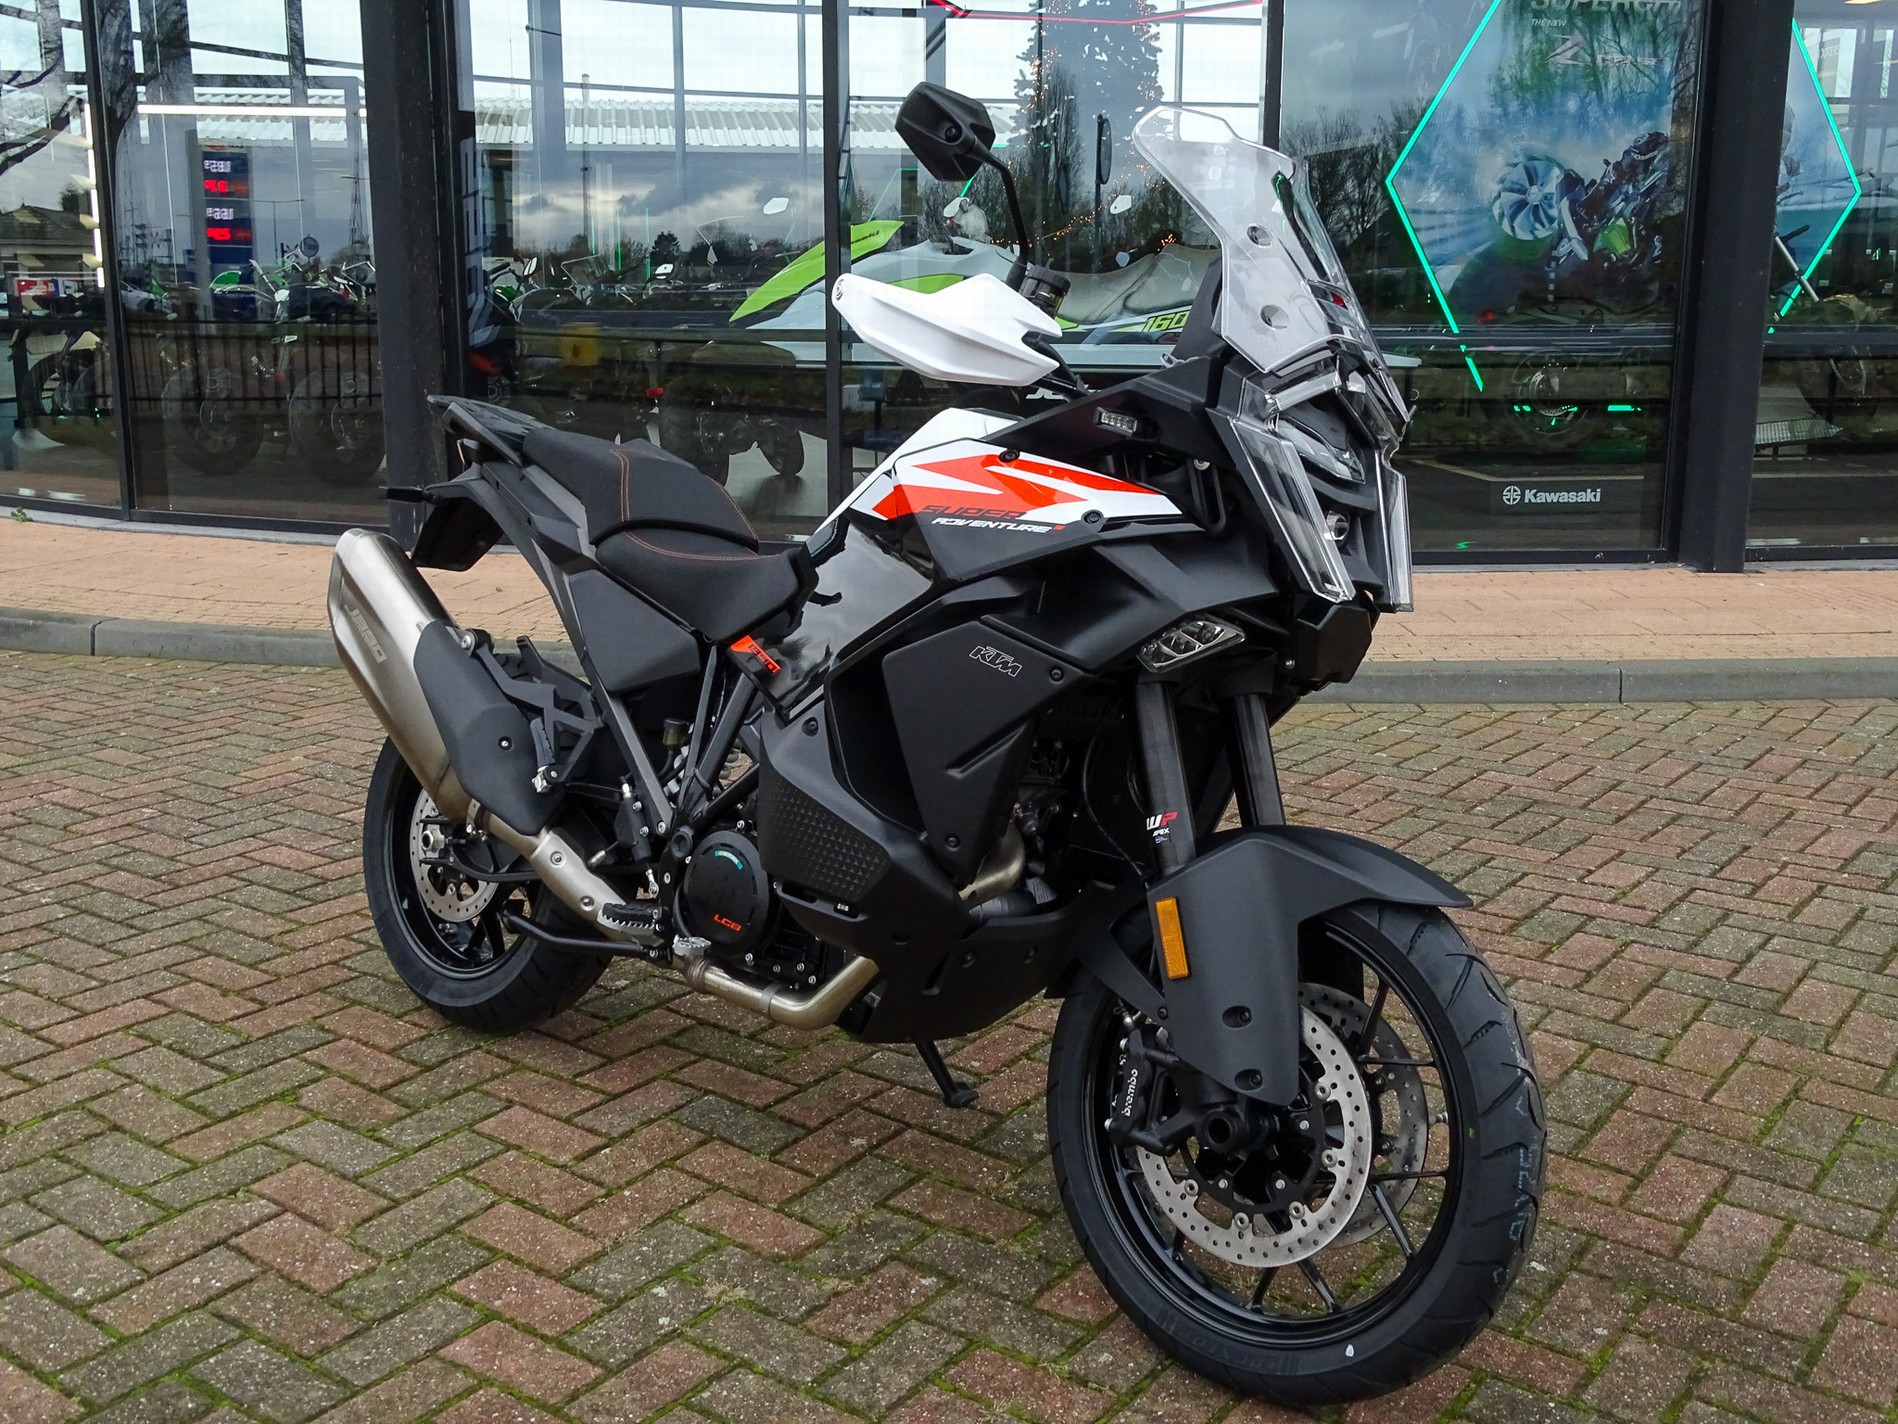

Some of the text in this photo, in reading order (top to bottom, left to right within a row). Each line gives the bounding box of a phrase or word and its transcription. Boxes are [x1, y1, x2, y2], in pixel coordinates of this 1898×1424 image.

[1530, 18, 1567, 28] THE NEW
[1142, 310, 1191, 333] 160
[1524, 488, 1601, 504] Kawasaki
[919, 504, 1028, 520] SUPER
[931, 517, 1053, 534] ADVENTURE
[969, 645, 1023, 678] KTM
[1146, 811, 1178, 831] WP
[714, 914, 742, 932] LC8
[1121, 1068, 1139, 1117] brembo
